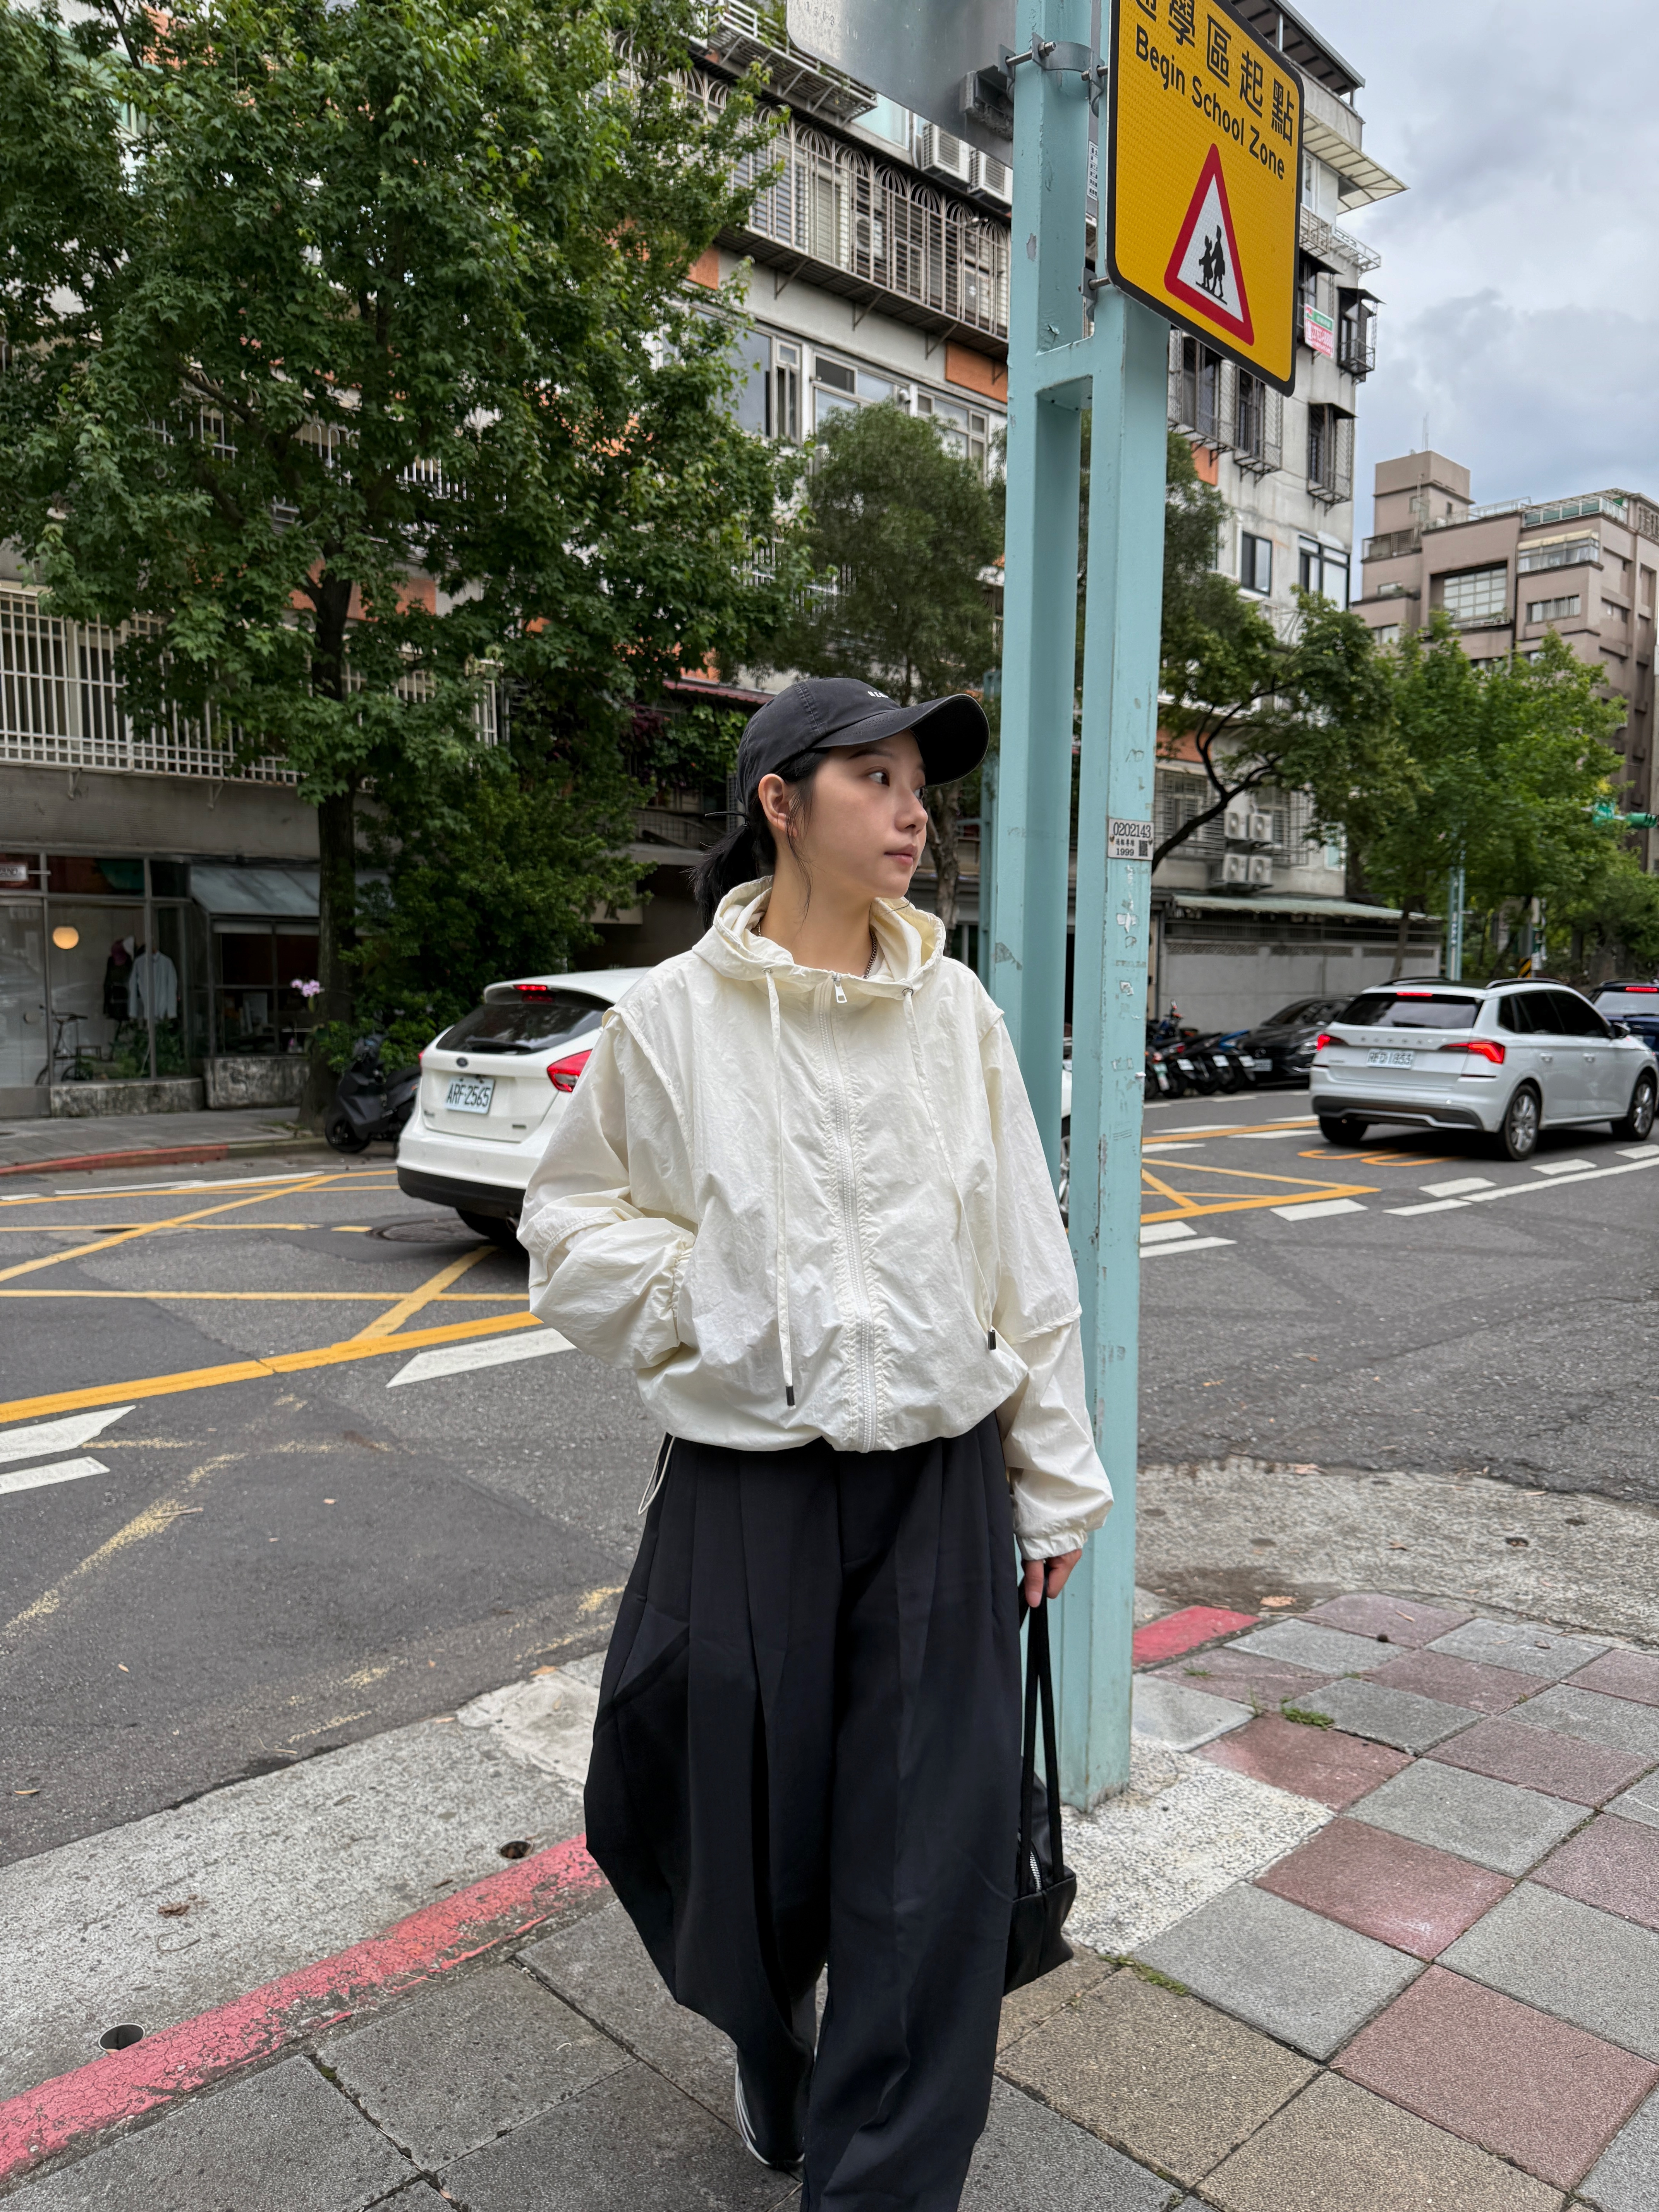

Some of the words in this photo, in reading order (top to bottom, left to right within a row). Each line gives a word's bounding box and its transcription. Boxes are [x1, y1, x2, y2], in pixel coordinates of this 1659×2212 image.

[1136, 22, 1185, 95] Begin
[1191, 75, 1244, 146] School
[1249, 125, 1285, 180] Zone
[1113, 822, 1151, 838] 0202143
[1116, 848, 1135, 856] 1999
